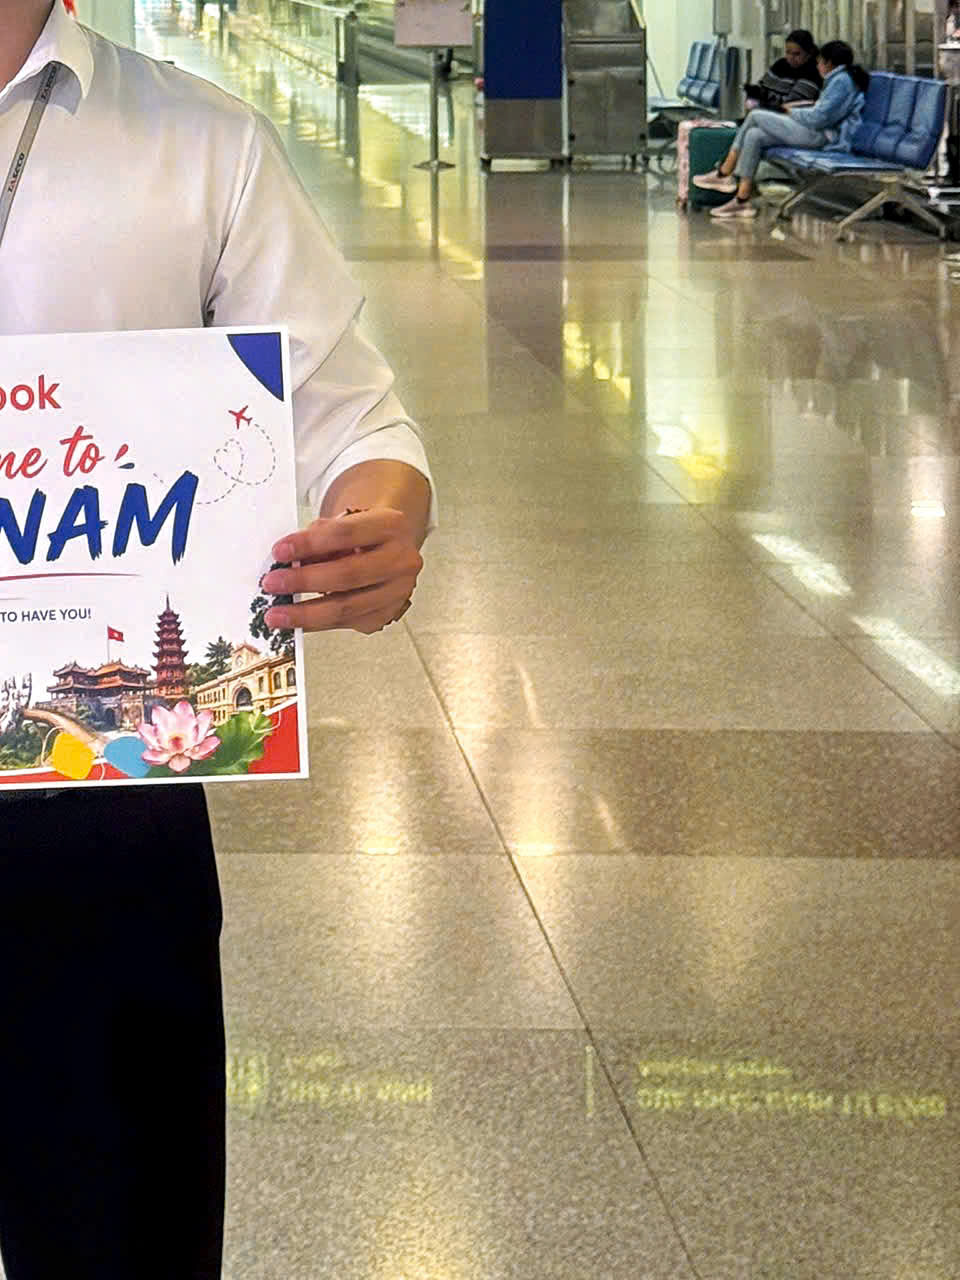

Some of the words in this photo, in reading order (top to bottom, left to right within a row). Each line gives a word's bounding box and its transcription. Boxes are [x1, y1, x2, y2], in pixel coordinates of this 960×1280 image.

[59, 425, 105, 477] to
[0, 611, 18, 623] TO
[22, 609, 57, 622] HAVE
[60, 608, 92, 620] YOU!
